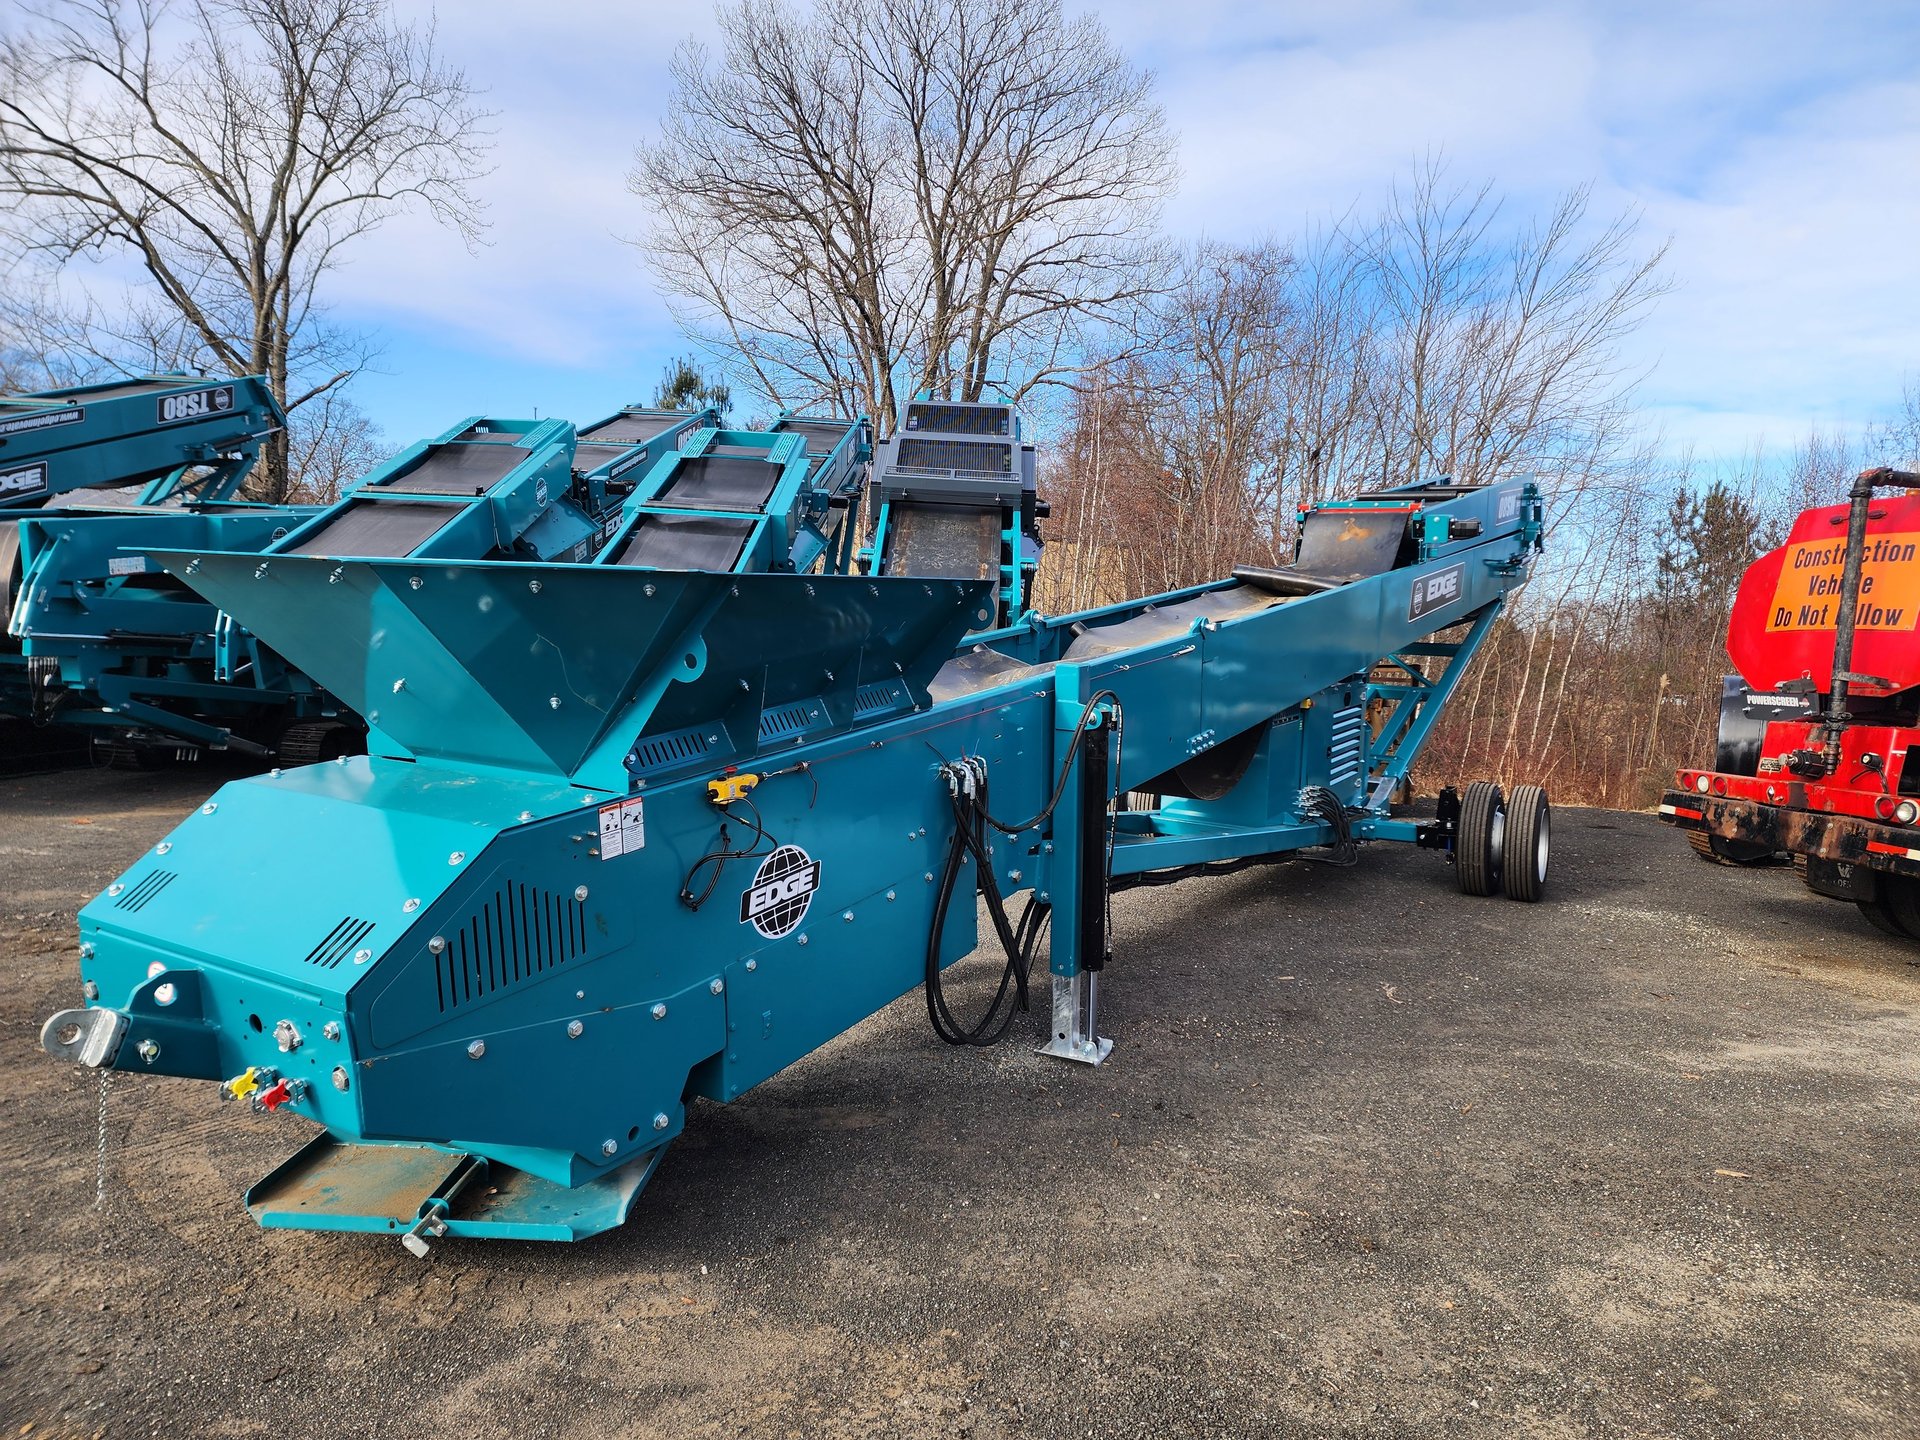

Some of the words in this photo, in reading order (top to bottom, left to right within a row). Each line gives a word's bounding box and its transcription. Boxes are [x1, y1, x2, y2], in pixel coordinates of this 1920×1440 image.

[163, 392, 210, 420] TS80
[605, 511, 625, 538] EDG
[1794, 540, 1916, 569] Constrction
[1426, 570, 1459, 603] EDGE
[1808, 572, 1874, 596] Vehie
[1774, 607, 1793, 628] Do
[1797, 604, 1829, 626] Not
[1834, 603, 1904, 627] llow
[1746, 694, 1800, 707] POWERSCREEN
[748, 865, 815, 917] EDGE
